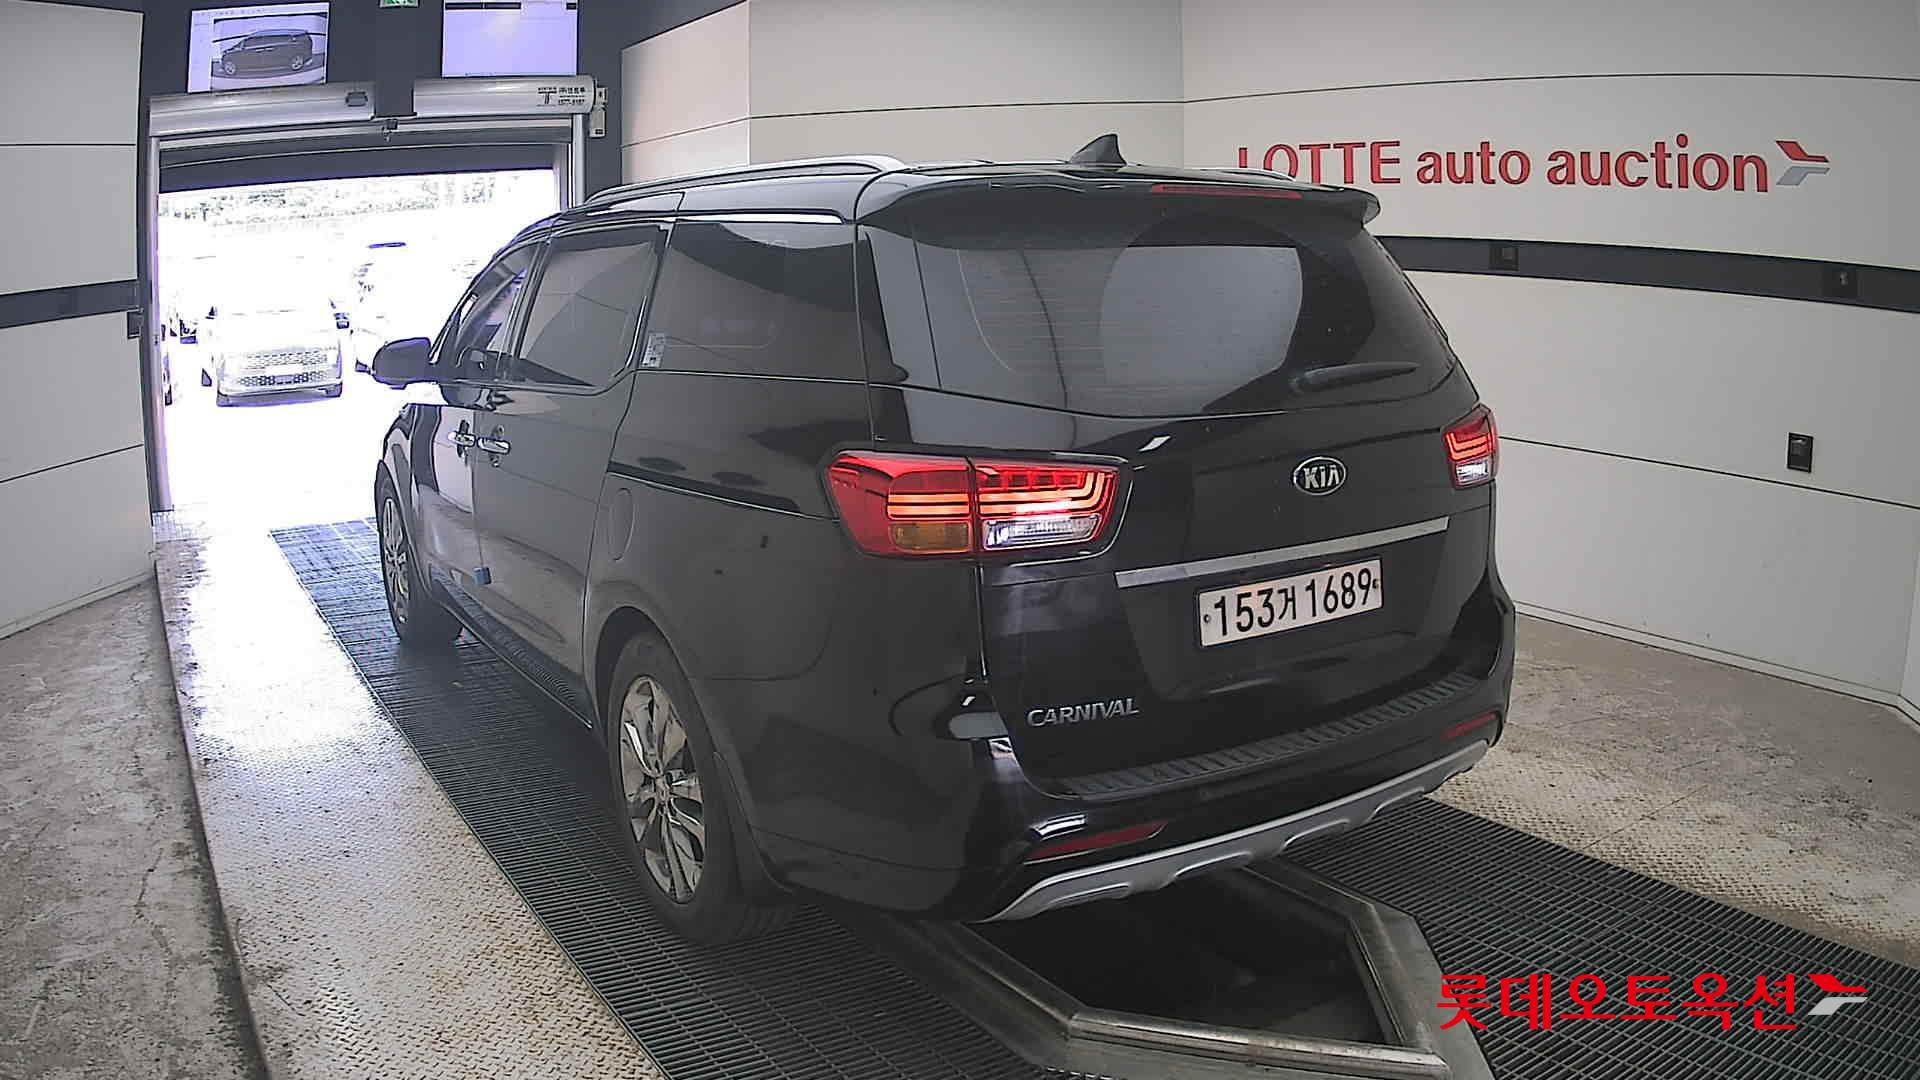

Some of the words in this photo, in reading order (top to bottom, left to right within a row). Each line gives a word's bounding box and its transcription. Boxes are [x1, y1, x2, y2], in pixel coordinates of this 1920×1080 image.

[1416, 141, 1531, 185] auto
[1547, 133, 1769, 193] auction
[1303, 464, 1340, 489] KIA
[1214, 585, 1297, 637] 153거
[1305, 567, 1373, 617] 1689
[1027, 698, 1139, 727] CARNIVAL
